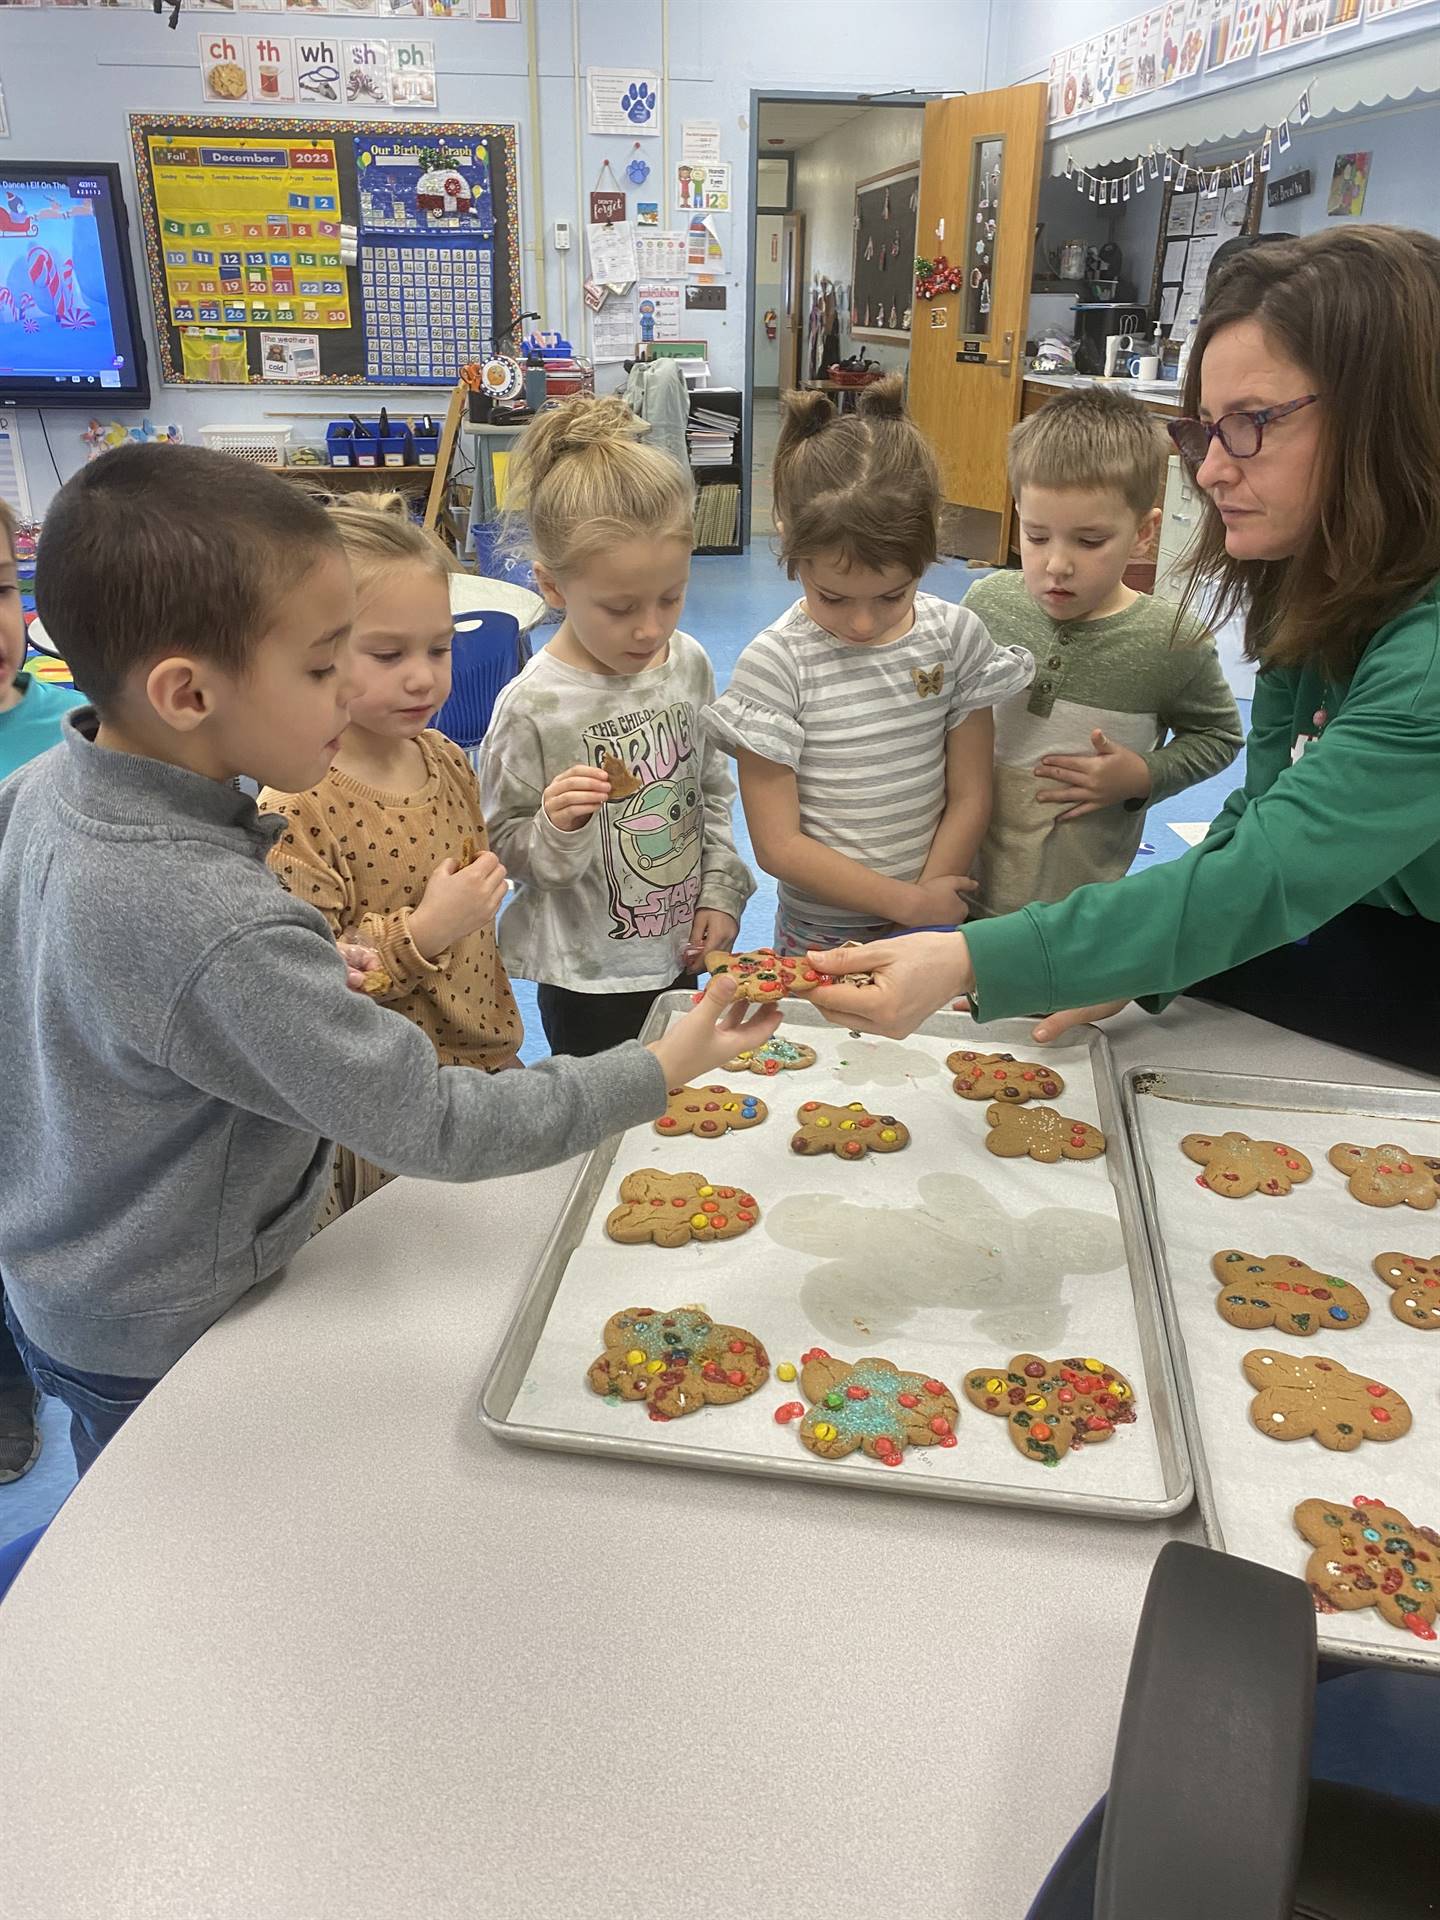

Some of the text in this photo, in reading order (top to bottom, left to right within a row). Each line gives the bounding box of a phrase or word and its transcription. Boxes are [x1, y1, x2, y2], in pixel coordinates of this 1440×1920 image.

[1165, 5, 1174, 28] 6
[1142, 16, 1150, 37] 5
[1121, 25, 1129, 46] 4
[210, 38, 236, 61] ch
[1102, 35, 1109, 55] 3
[257, 40, 280, 62] th
[301, 42, 334, 63] wh
[353, 44, 376, 65] sh
[399, 45, 424, 70] ph
[371, 145, 390, 155] Our
[442, 145, 472, 156] Graph
[167, 152, 186, 161] Fall
[212, 152, 276, 163] December
[295, 153, 328, 163] 2023
[3, 181, 25, 189] Dance
[30, 181, 40, 189] Elf
[52, 182, 66, 190] The
[296, 197, 328, 207] 1 2
[594, 198, 622, 220] forget
[170, 223, 332, 235] 3 4 5 6 7 8 9
[170, 252, 337, 265] 10 11 12 13 14 15 16
[377, 249, 383, 257] 2
[443, 251, 448, 259] 7
[468, 252, 473, 260] 9
[468, 265, 476, 273] 19
[390, 276, 399, 284] 23
[429, 277, 438, 285] 26
[177, 282, 340, 292] 17 18 19 20 21 22 23
[377, 289, 386, 297] 32
[390, 289, 399, 297] 33
[176, 310, 345, 320] 24 25 26 27 28 29 30
[368, 315, 376, 323] 51
[277, 336, 306, 344] weather
[370, 353, 377, 361] 81
[268, 364, 284, 372] cold
[369, 366, 377, 374] 91
[589, 709, 652, 737] THE CHILD
[634, 876, 699, 917] STAR
